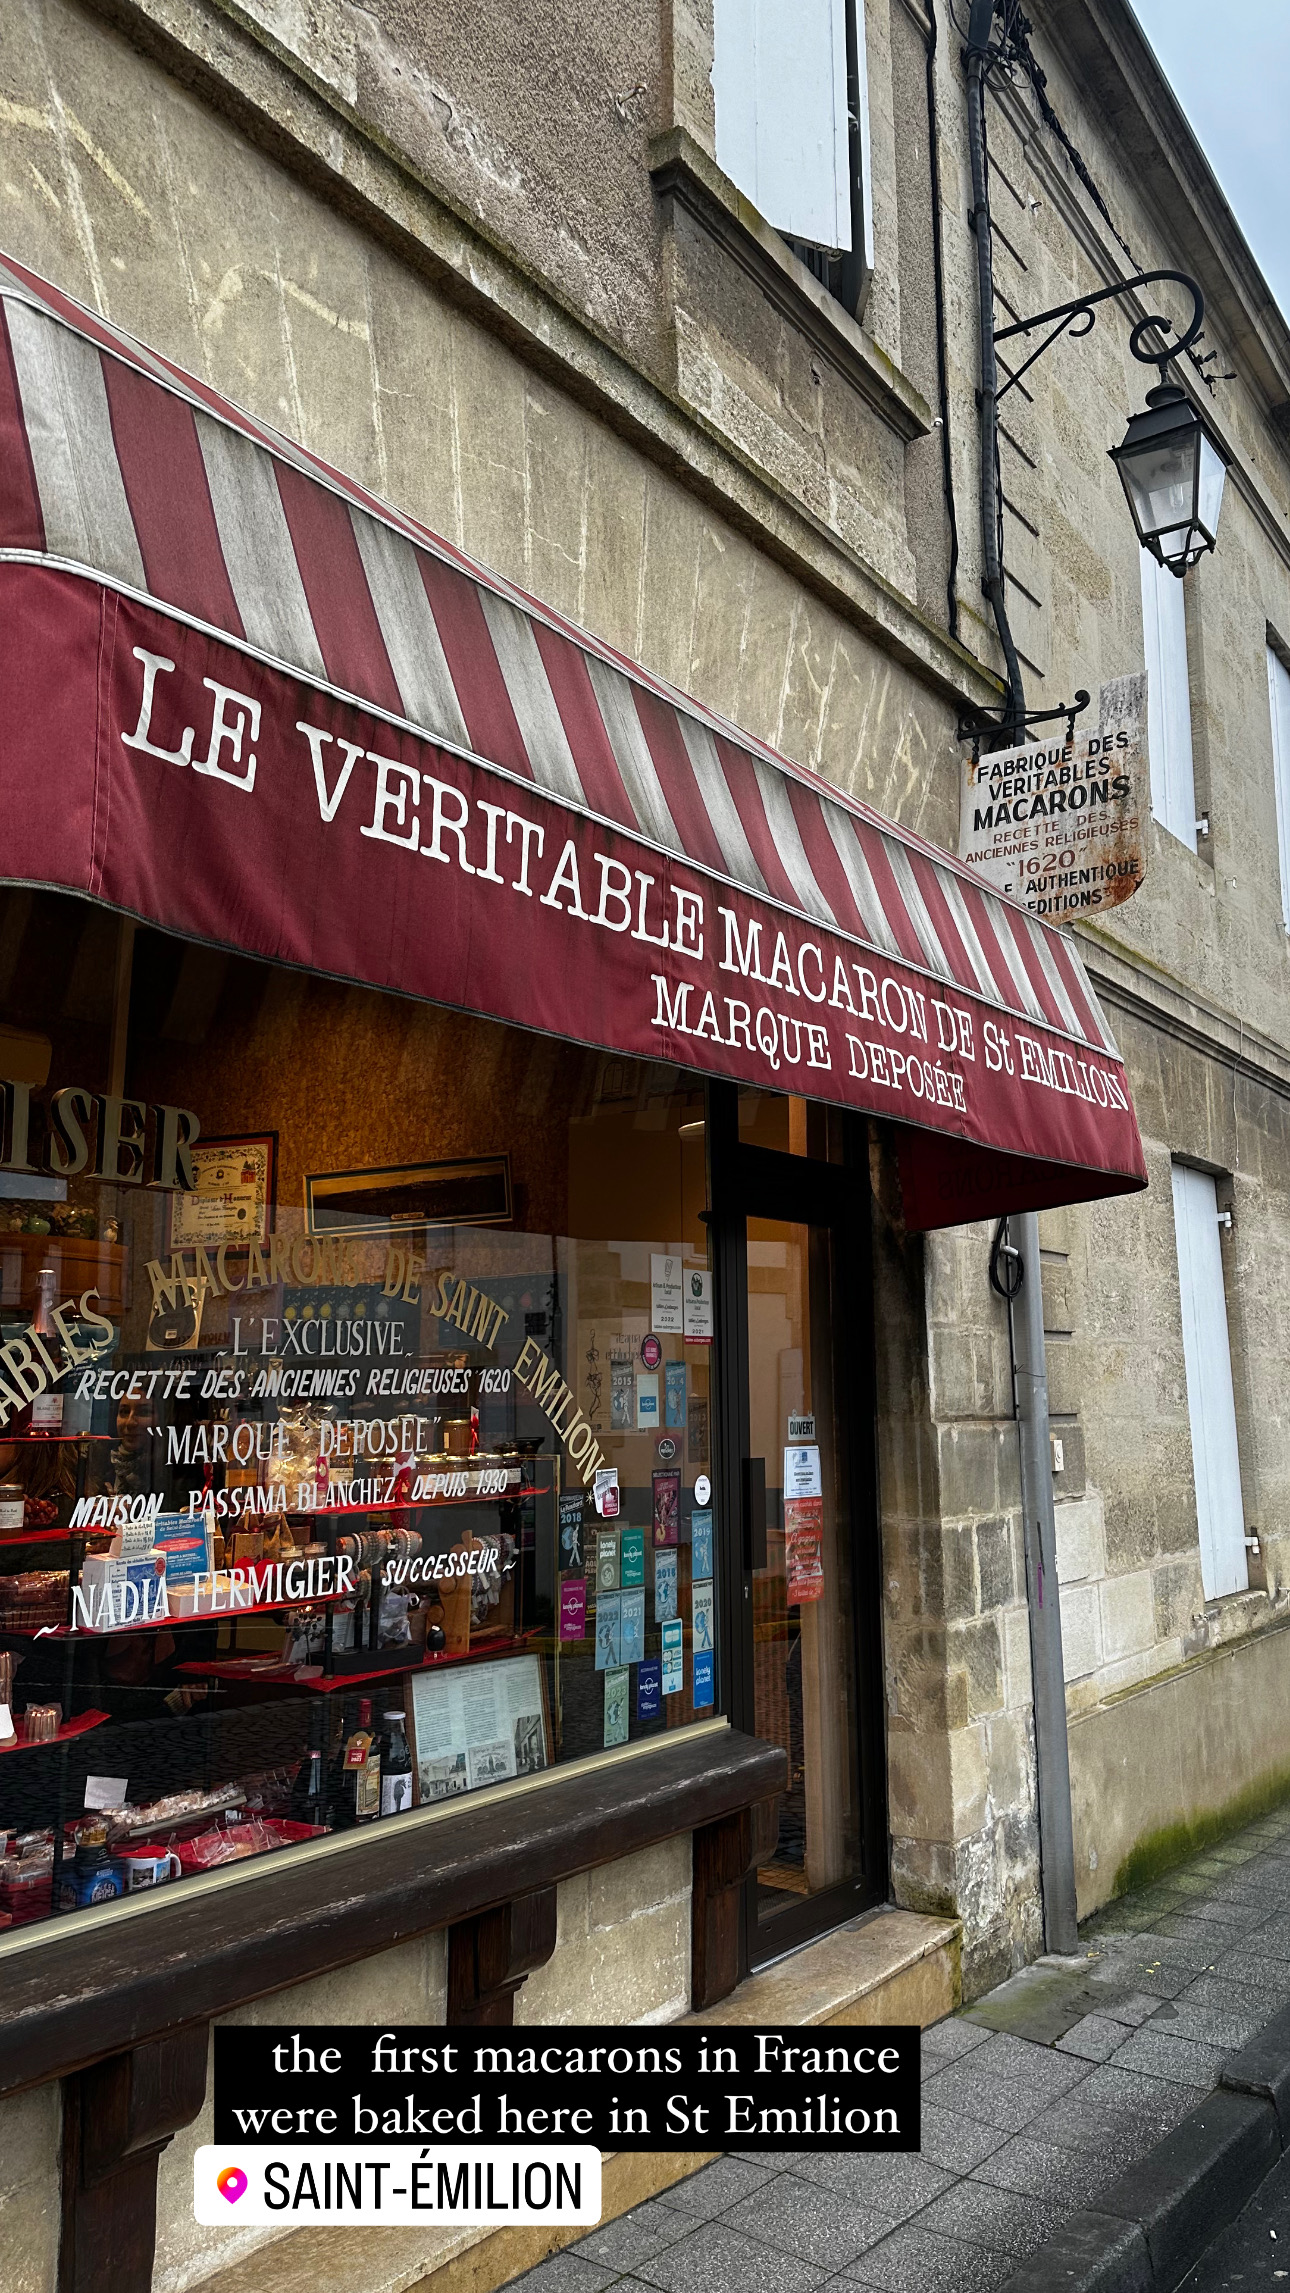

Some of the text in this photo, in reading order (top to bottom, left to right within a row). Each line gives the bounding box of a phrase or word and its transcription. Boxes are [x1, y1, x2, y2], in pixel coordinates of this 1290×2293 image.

[977, 731, 1129, 784] FABRIQUE DES
[989, 756, 1110, 801] VERITABLES
[973, 775, 1130, 831] MACARONS
[965, 817, 1139, 864] ANCIENNES RELIGIEUSES
[993, 810, 1108, 844] RECETTE DES
[120, 646, 1130, 1112] LE VERITABLE MACARON DE St EMILION
[1025, 858, 1140, 894] AUTHENTIQUE
[1022, 888, 1103, 915] EDITIONS
[650, 974, 967, 1113] MARQUE DEPOSÉE
[0, 1080, 201, 1191] ISER
[232, 1317, 406, 1357] L'EXCLUSIVE
[0, 1286, 114, 1425] ABLES
[143, 1233, 360, 1317] MACARONS
[380, 1247, 425, 1305] DE
[430, 1272, 509, 1351] SAINT
[512, 1336, 606, 1485] EMILION
[74, 1368, 511, 1400] RECETTE DES ANCIENNES RELIGIEUSES 1620
[613, 1377, 632, 1386] 2015
[790, 1421, 814, 1435] OUVERT
[69, 1469, 507, 1528] MAISON PASSAMA BLANCHEZ DEPUIS 1930
[561, 1512, 582, 1523] 2018
[693, 1528, 711, 1537] 2019
[70, 1576, 171, 1632] NADIA
[192, 1554, 356, 1613] FERMIGIER
[382, 1548, 499, 1586] SUCCESSEUR
[695, 1599, 712, 1609] 2020
[597, 1611, 619, 1622] 2022
[623, 1608, 641, 1618] 2021
[607, 1687, 627, 1699] 2023
